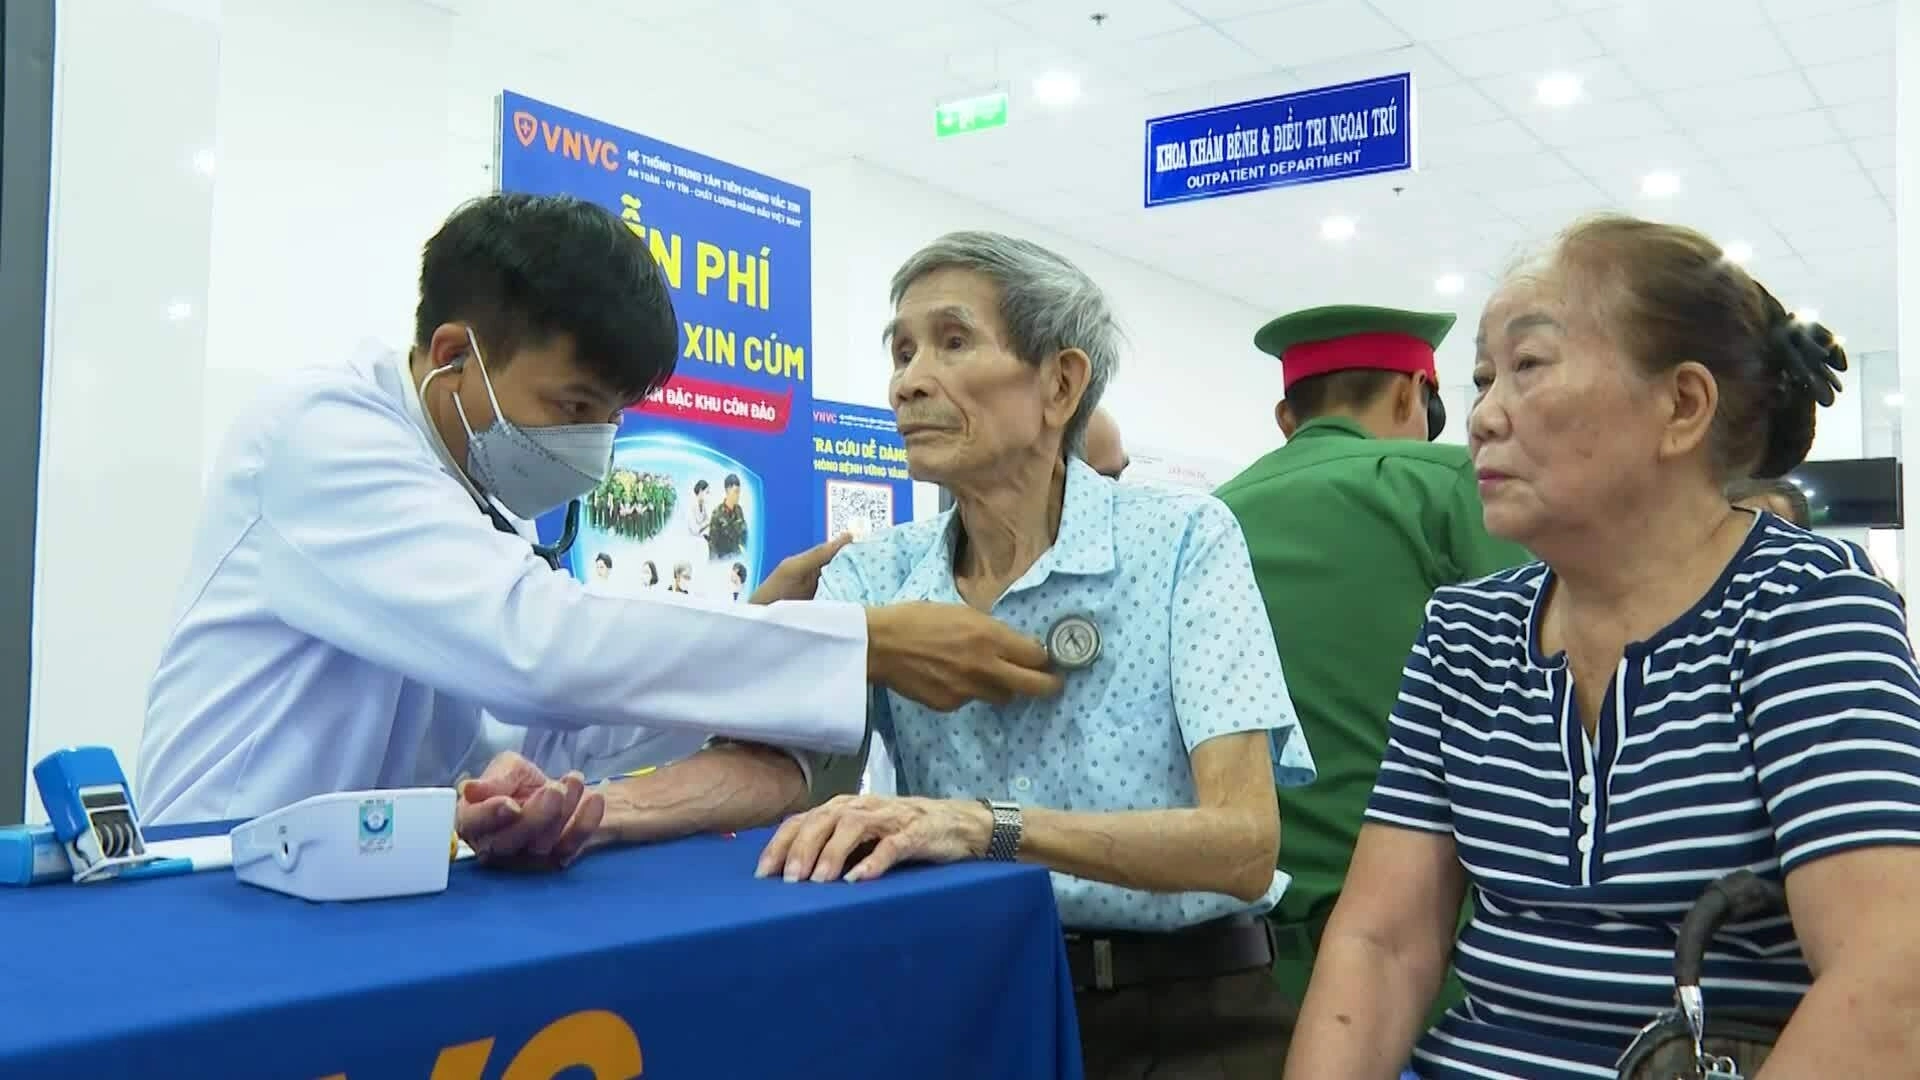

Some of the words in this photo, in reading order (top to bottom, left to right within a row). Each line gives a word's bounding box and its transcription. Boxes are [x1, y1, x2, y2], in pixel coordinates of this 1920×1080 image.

[541, 120, 619, 171] VNVC
[1156, 141, 1187, 173] KHOA
[1189, 127, 1223, 167] KHÁM
[1226, 123, 1258, 167] BỆNH
[1261, 125, 1270, 155] &
[1273, 105, 1303, 153] ĐIỀU
[1305, 117, 1327, 153] TRỊ
[1329, 109, 1368, 147] NGOẠI
[1371, 97, 1397, 137] TRÚ
[1187, 164, 1265, 189] OUTPATIENT
[1269, 149, 1361, 177] DEPARTMENT
[696, 240, 771, 311] PHÍ
[683, 322, 736, 366] XIN
[744, 332, 804, 381] CÚM
[666, 387, 693, 410] ĐẶC
[695, 393, 721, 412] KHU
[723, 396, 748, 417] CÔN
[751, 400, 776, 422] ĐẢO
